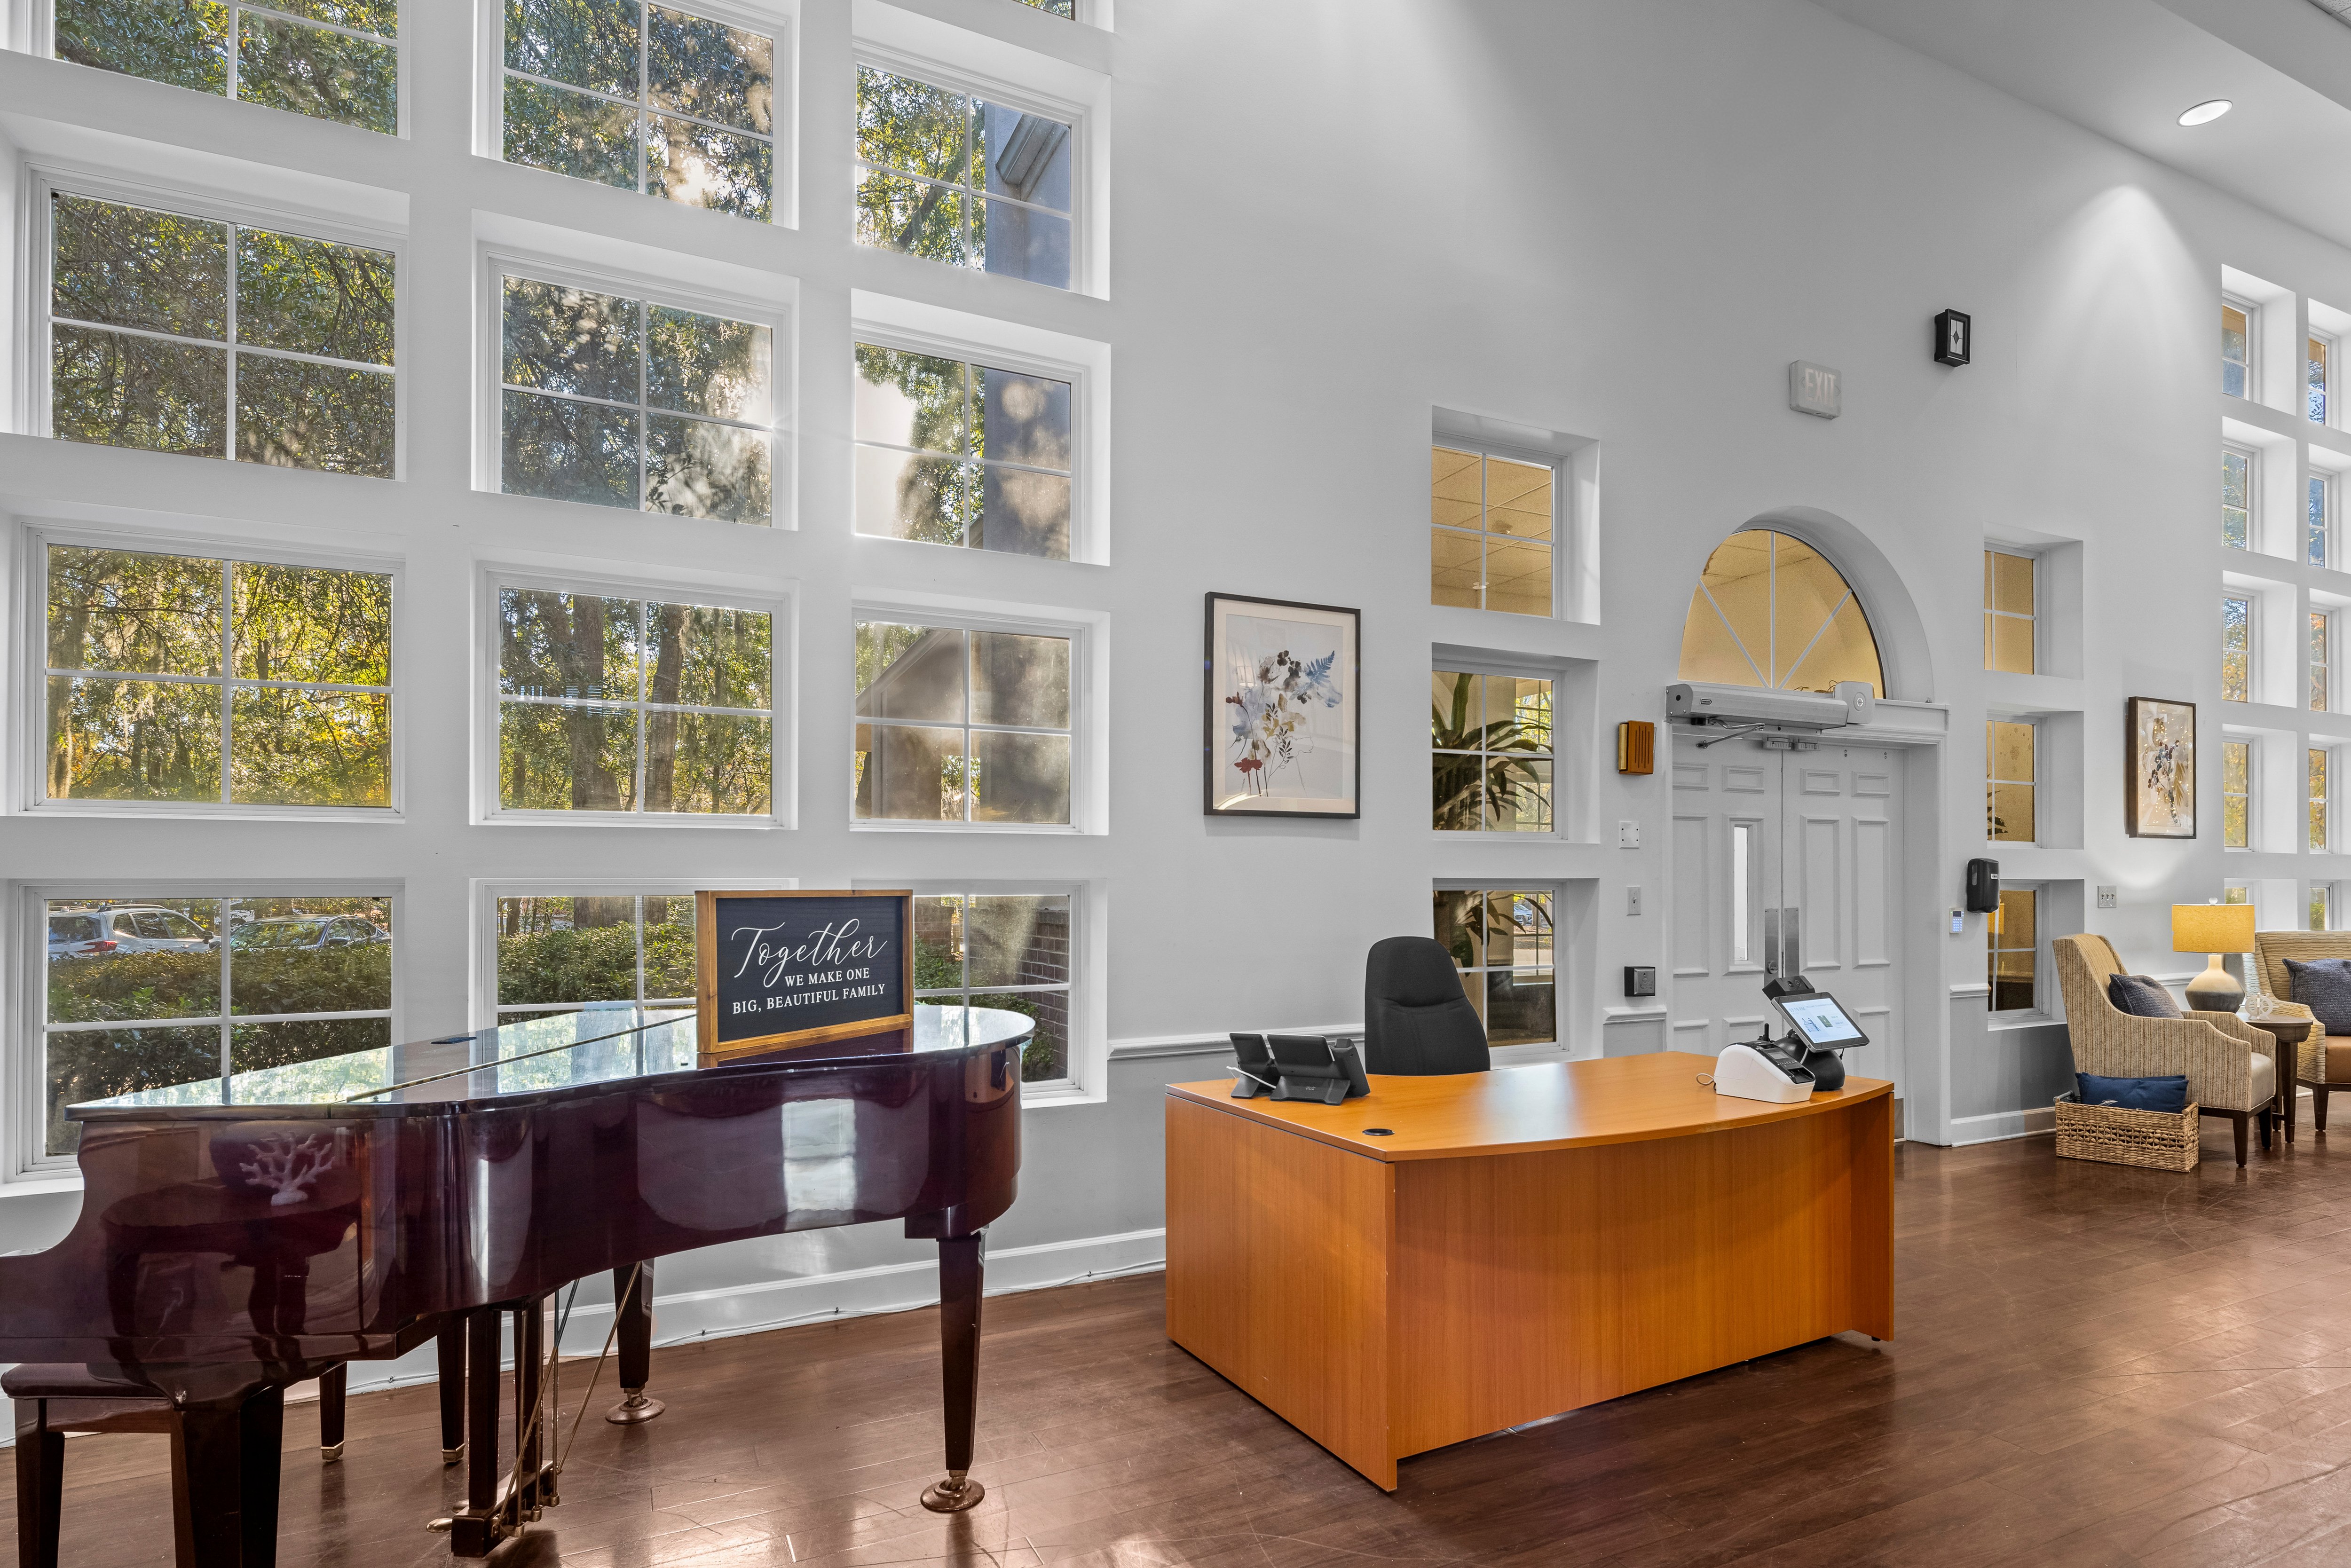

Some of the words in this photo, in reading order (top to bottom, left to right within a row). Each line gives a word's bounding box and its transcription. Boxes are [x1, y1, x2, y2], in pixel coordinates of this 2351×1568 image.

[1805, 368, 1836, 407] EXIT
[732, 918, 888, 988] Together
[785, 974, 804, 987] WE
[808, 971, 842, 984] MAKE
[847, 968, 869, 980] ONE
[733, 1000, 762, 1014] BIG,
[767, 990, 838, 1009] BEAUTIFUL
[843, 984, 885, 999] FAMILY
